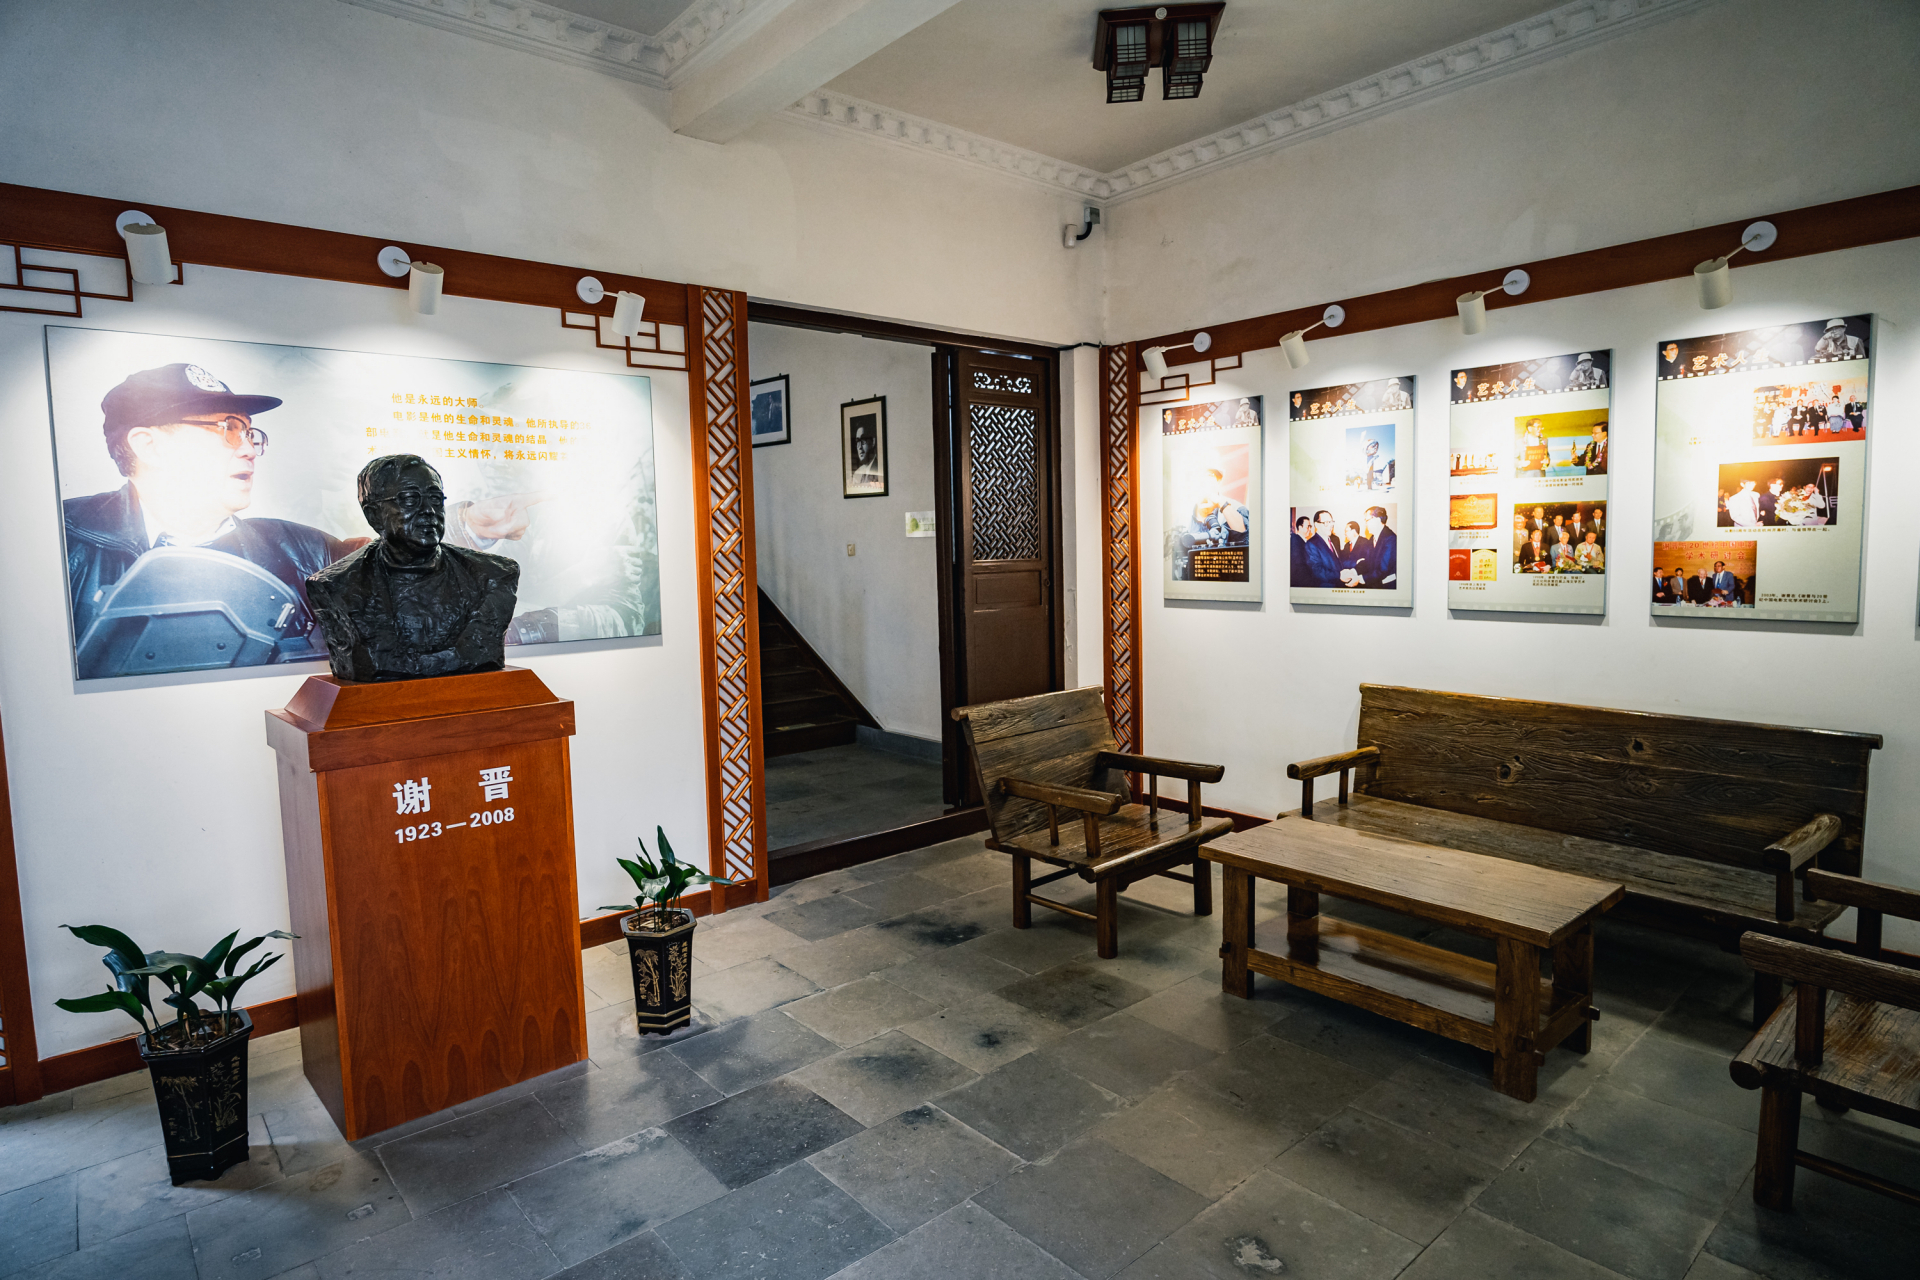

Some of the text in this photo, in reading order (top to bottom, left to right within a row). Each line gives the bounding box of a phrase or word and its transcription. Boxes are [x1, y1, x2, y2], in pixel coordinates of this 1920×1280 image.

[1692, 348, 1769, 370] 艺术人生
[1477, 377, 1536, 396] 艺术人生
[392, 393, 485, 409] 他是永远的大师。
[1310, 399, 1356, 415] 艺术人生
